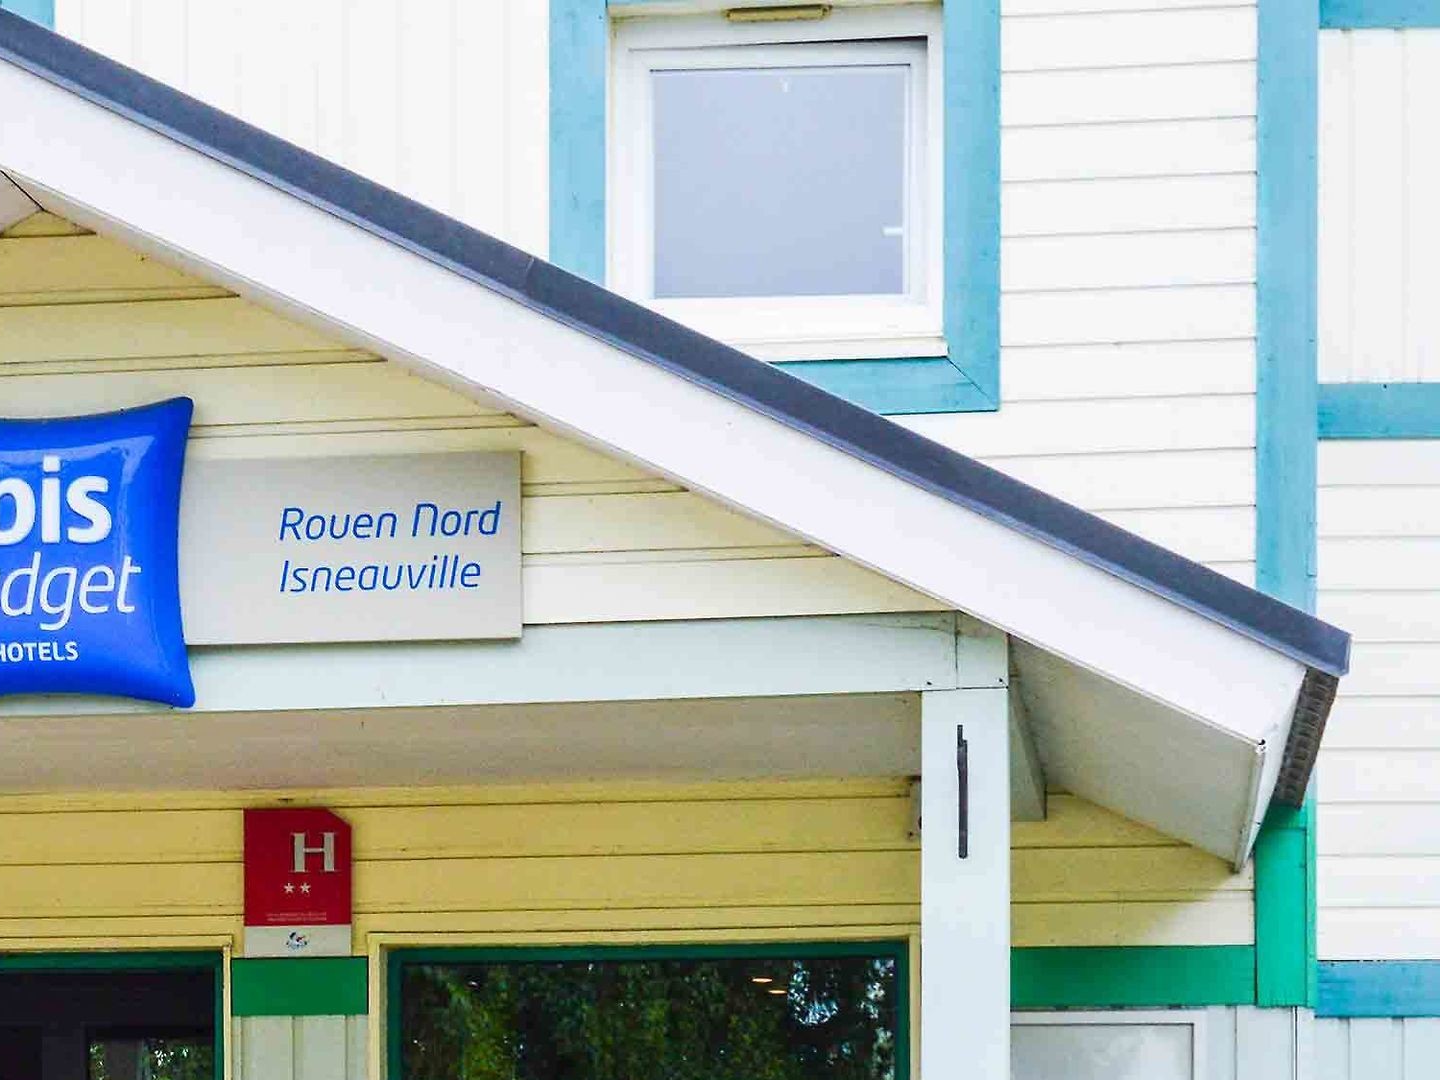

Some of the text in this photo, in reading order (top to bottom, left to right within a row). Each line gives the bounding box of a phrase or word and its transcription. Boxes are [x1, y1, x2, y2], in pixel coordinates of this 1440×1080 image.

[278, 500, 501, 542] Rouen Nord
[279, 554, 481, 594] Isneauville
[291, 832, 338, 872] H
